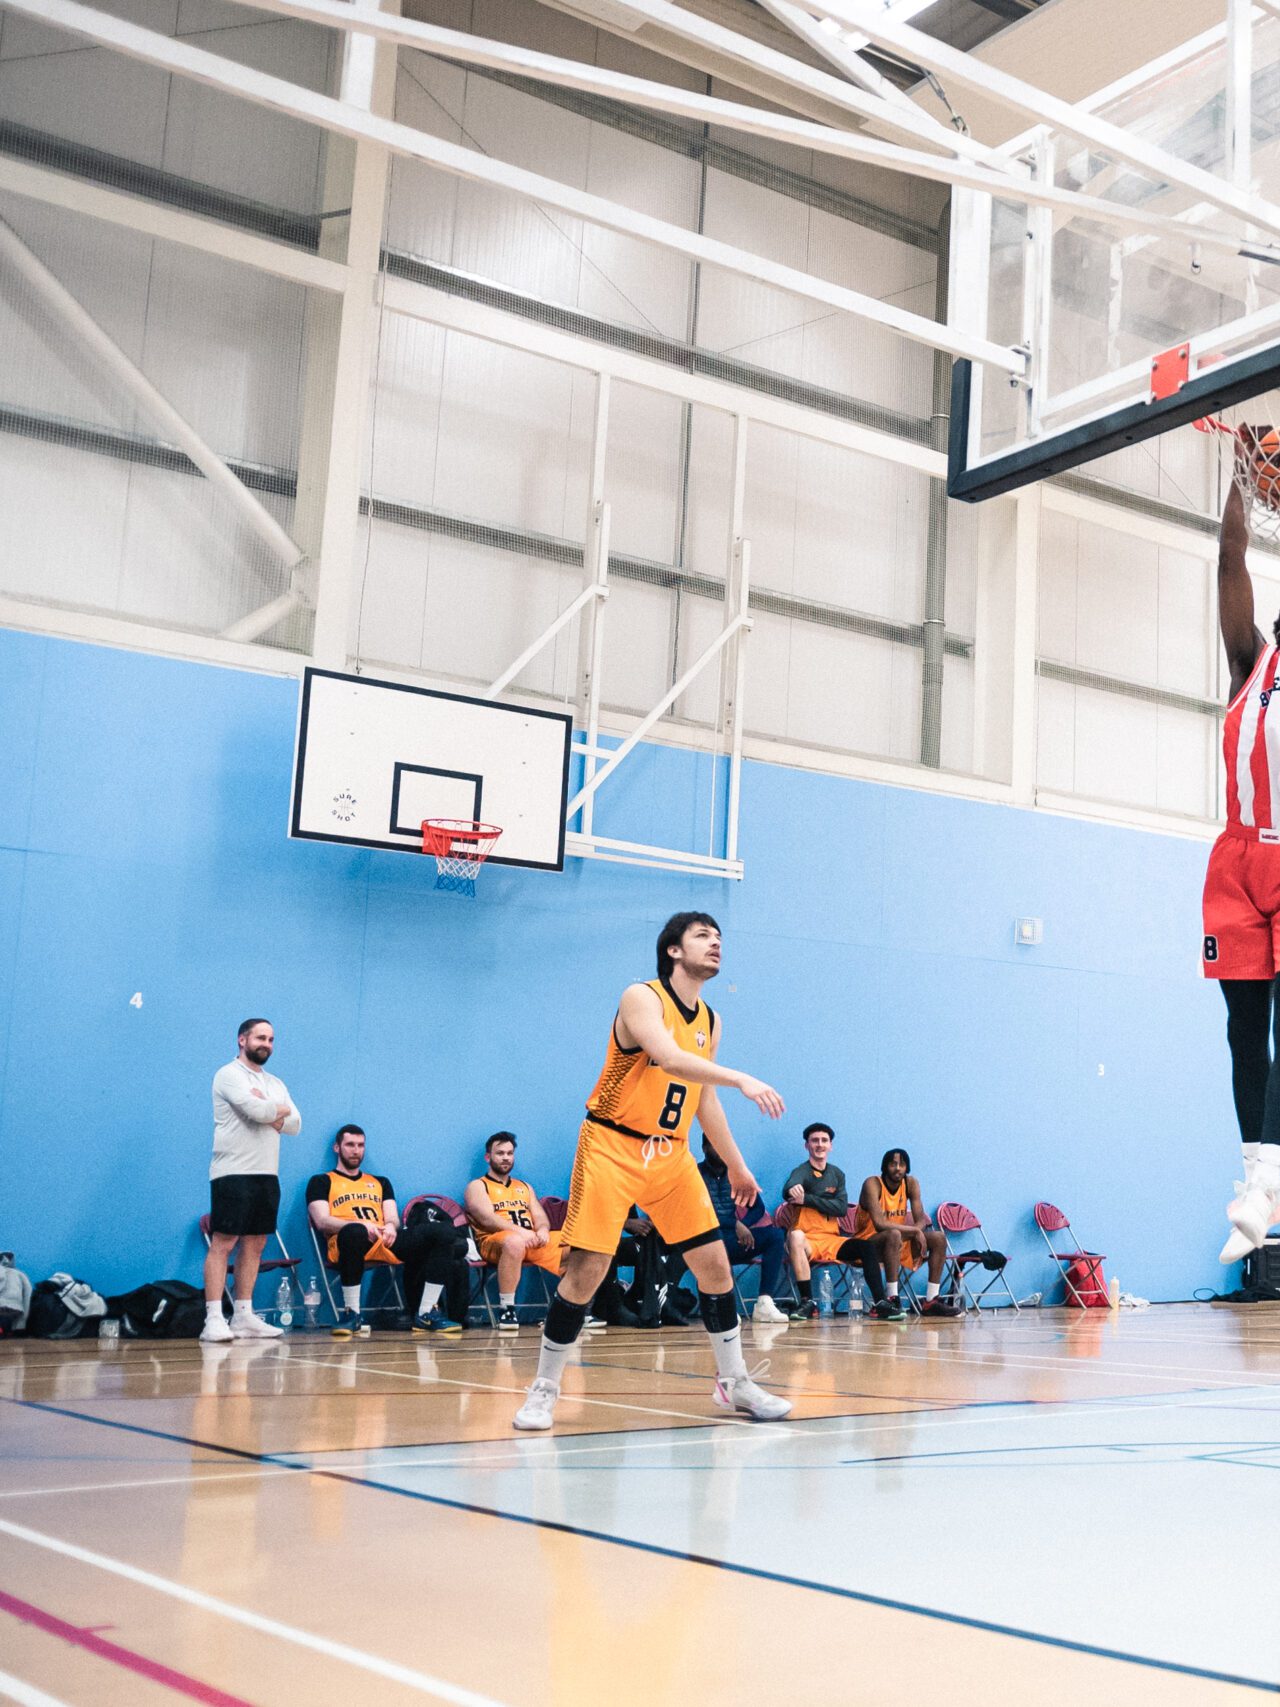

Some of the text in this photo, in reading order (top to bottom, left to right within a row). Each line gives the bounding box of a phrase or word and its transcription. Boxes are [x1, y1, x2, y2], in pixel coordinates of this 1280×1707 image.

[331, 809, 356, 822] SHOT
[1203, 935, 1218, 961] 8
[658, 1082, 687, 1130] 8
[508, 1209, 533, 1231] 16
